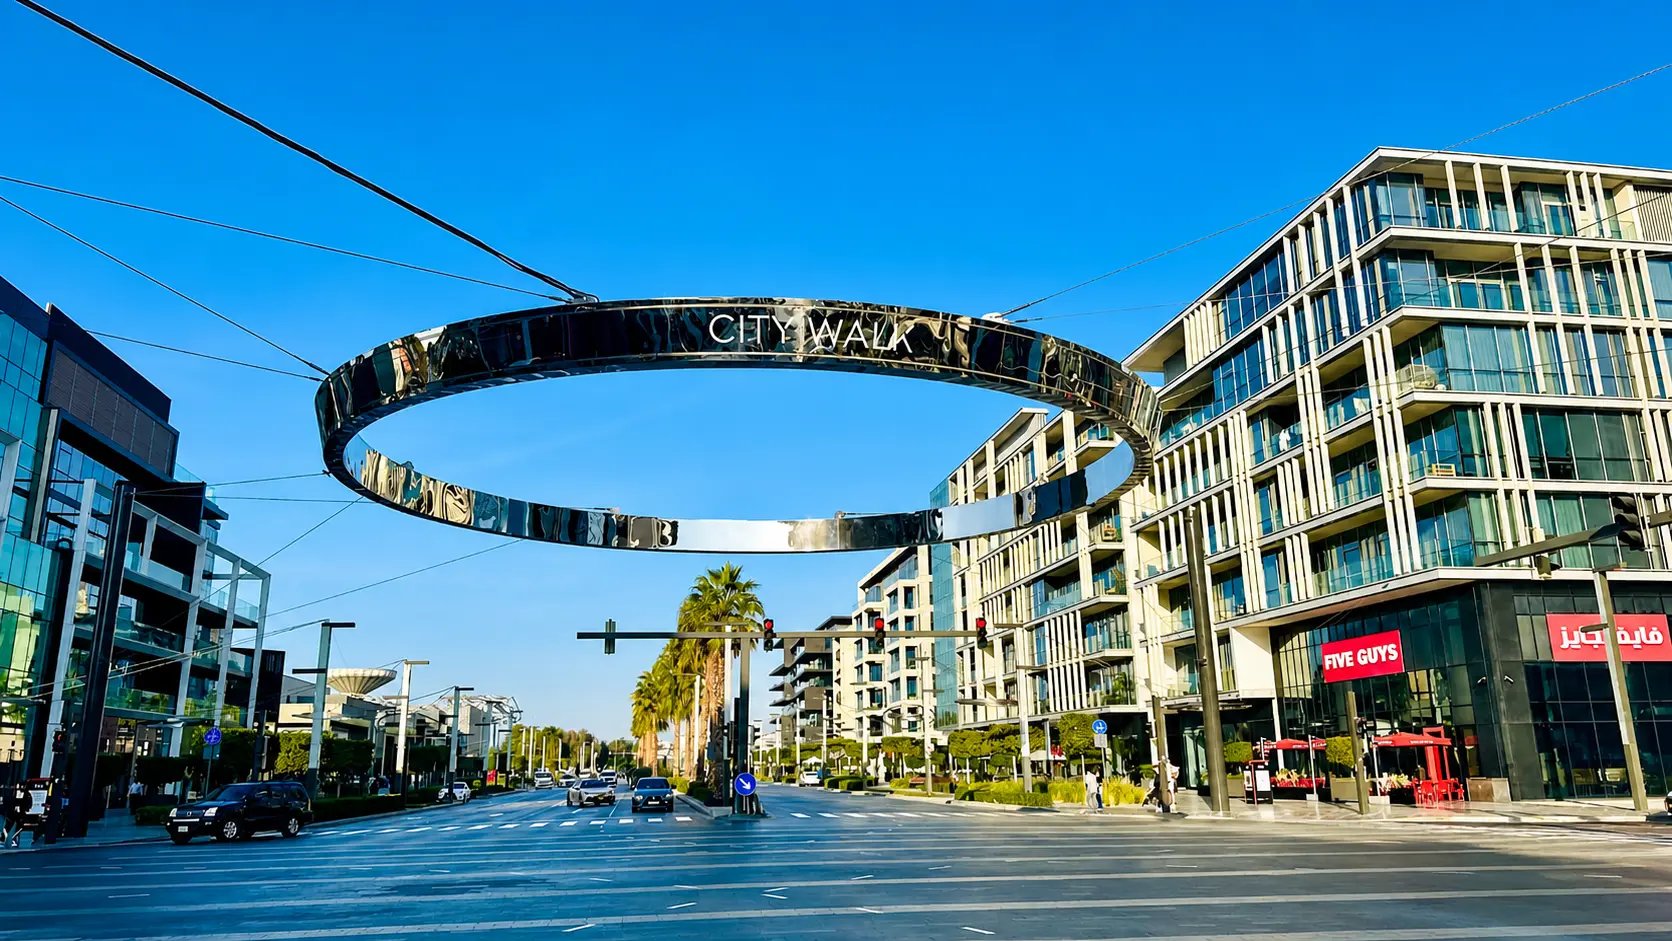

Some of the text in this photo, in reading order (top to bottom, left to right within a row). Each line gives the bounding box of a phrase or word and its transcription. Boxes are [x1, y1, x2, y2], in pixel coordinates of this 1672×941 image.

[709, 314, 915, 354] CITY WALK
[1324, 643, 1398, 670] FIVE GUYS
